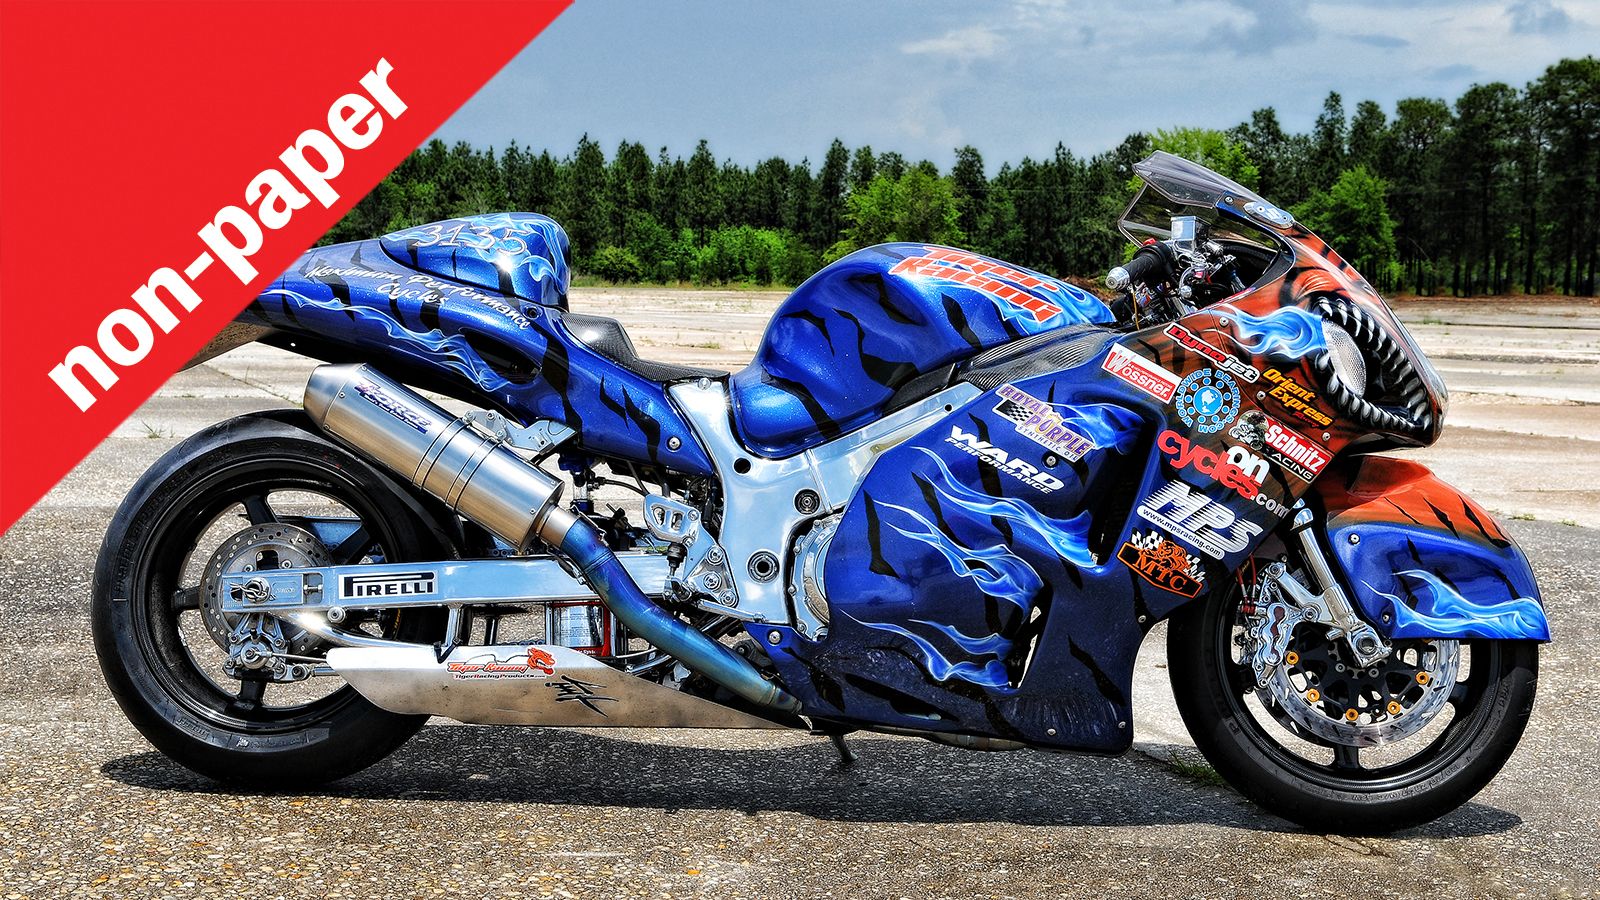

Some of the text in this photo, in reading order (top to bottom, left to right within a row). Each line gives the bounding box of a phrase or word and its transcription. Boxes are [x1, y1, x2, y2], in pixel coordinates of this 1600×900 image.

[414, 224, 529, 254] 3135
[304, 265, 531, 331] Maximum Performance
[377, 282, 448, 305] Cycles
[888, 256, 1063, 323] Racing
[1165, 324, 1259, 383] Dynojet
[1000, 385, 1050, 417] ROYAL
[1176, 368, 1211, 427] WORLDWIDE
[1263, 368, 1316, 402] Orient
[1269, 386, 1333, 426] Express
[1018, 425, 1060, 451] SYNTHETIC
[1024, 413, 1093, 456] PURPLE
[1265, 424, 1325, 473] Schnitz
[944, 436, 1053, 494] PERFORMANCE
[951, 425, 1064, 491] WARD
[1226, 446, 1270, 484] on
[1142, 479, 1263, 553] MPS
[1142, 508, 1221, 557] www.mpsracing.com
[344, 572, 435, 597] PIRELLI
[1132, 556, 1187, 591] MTC
